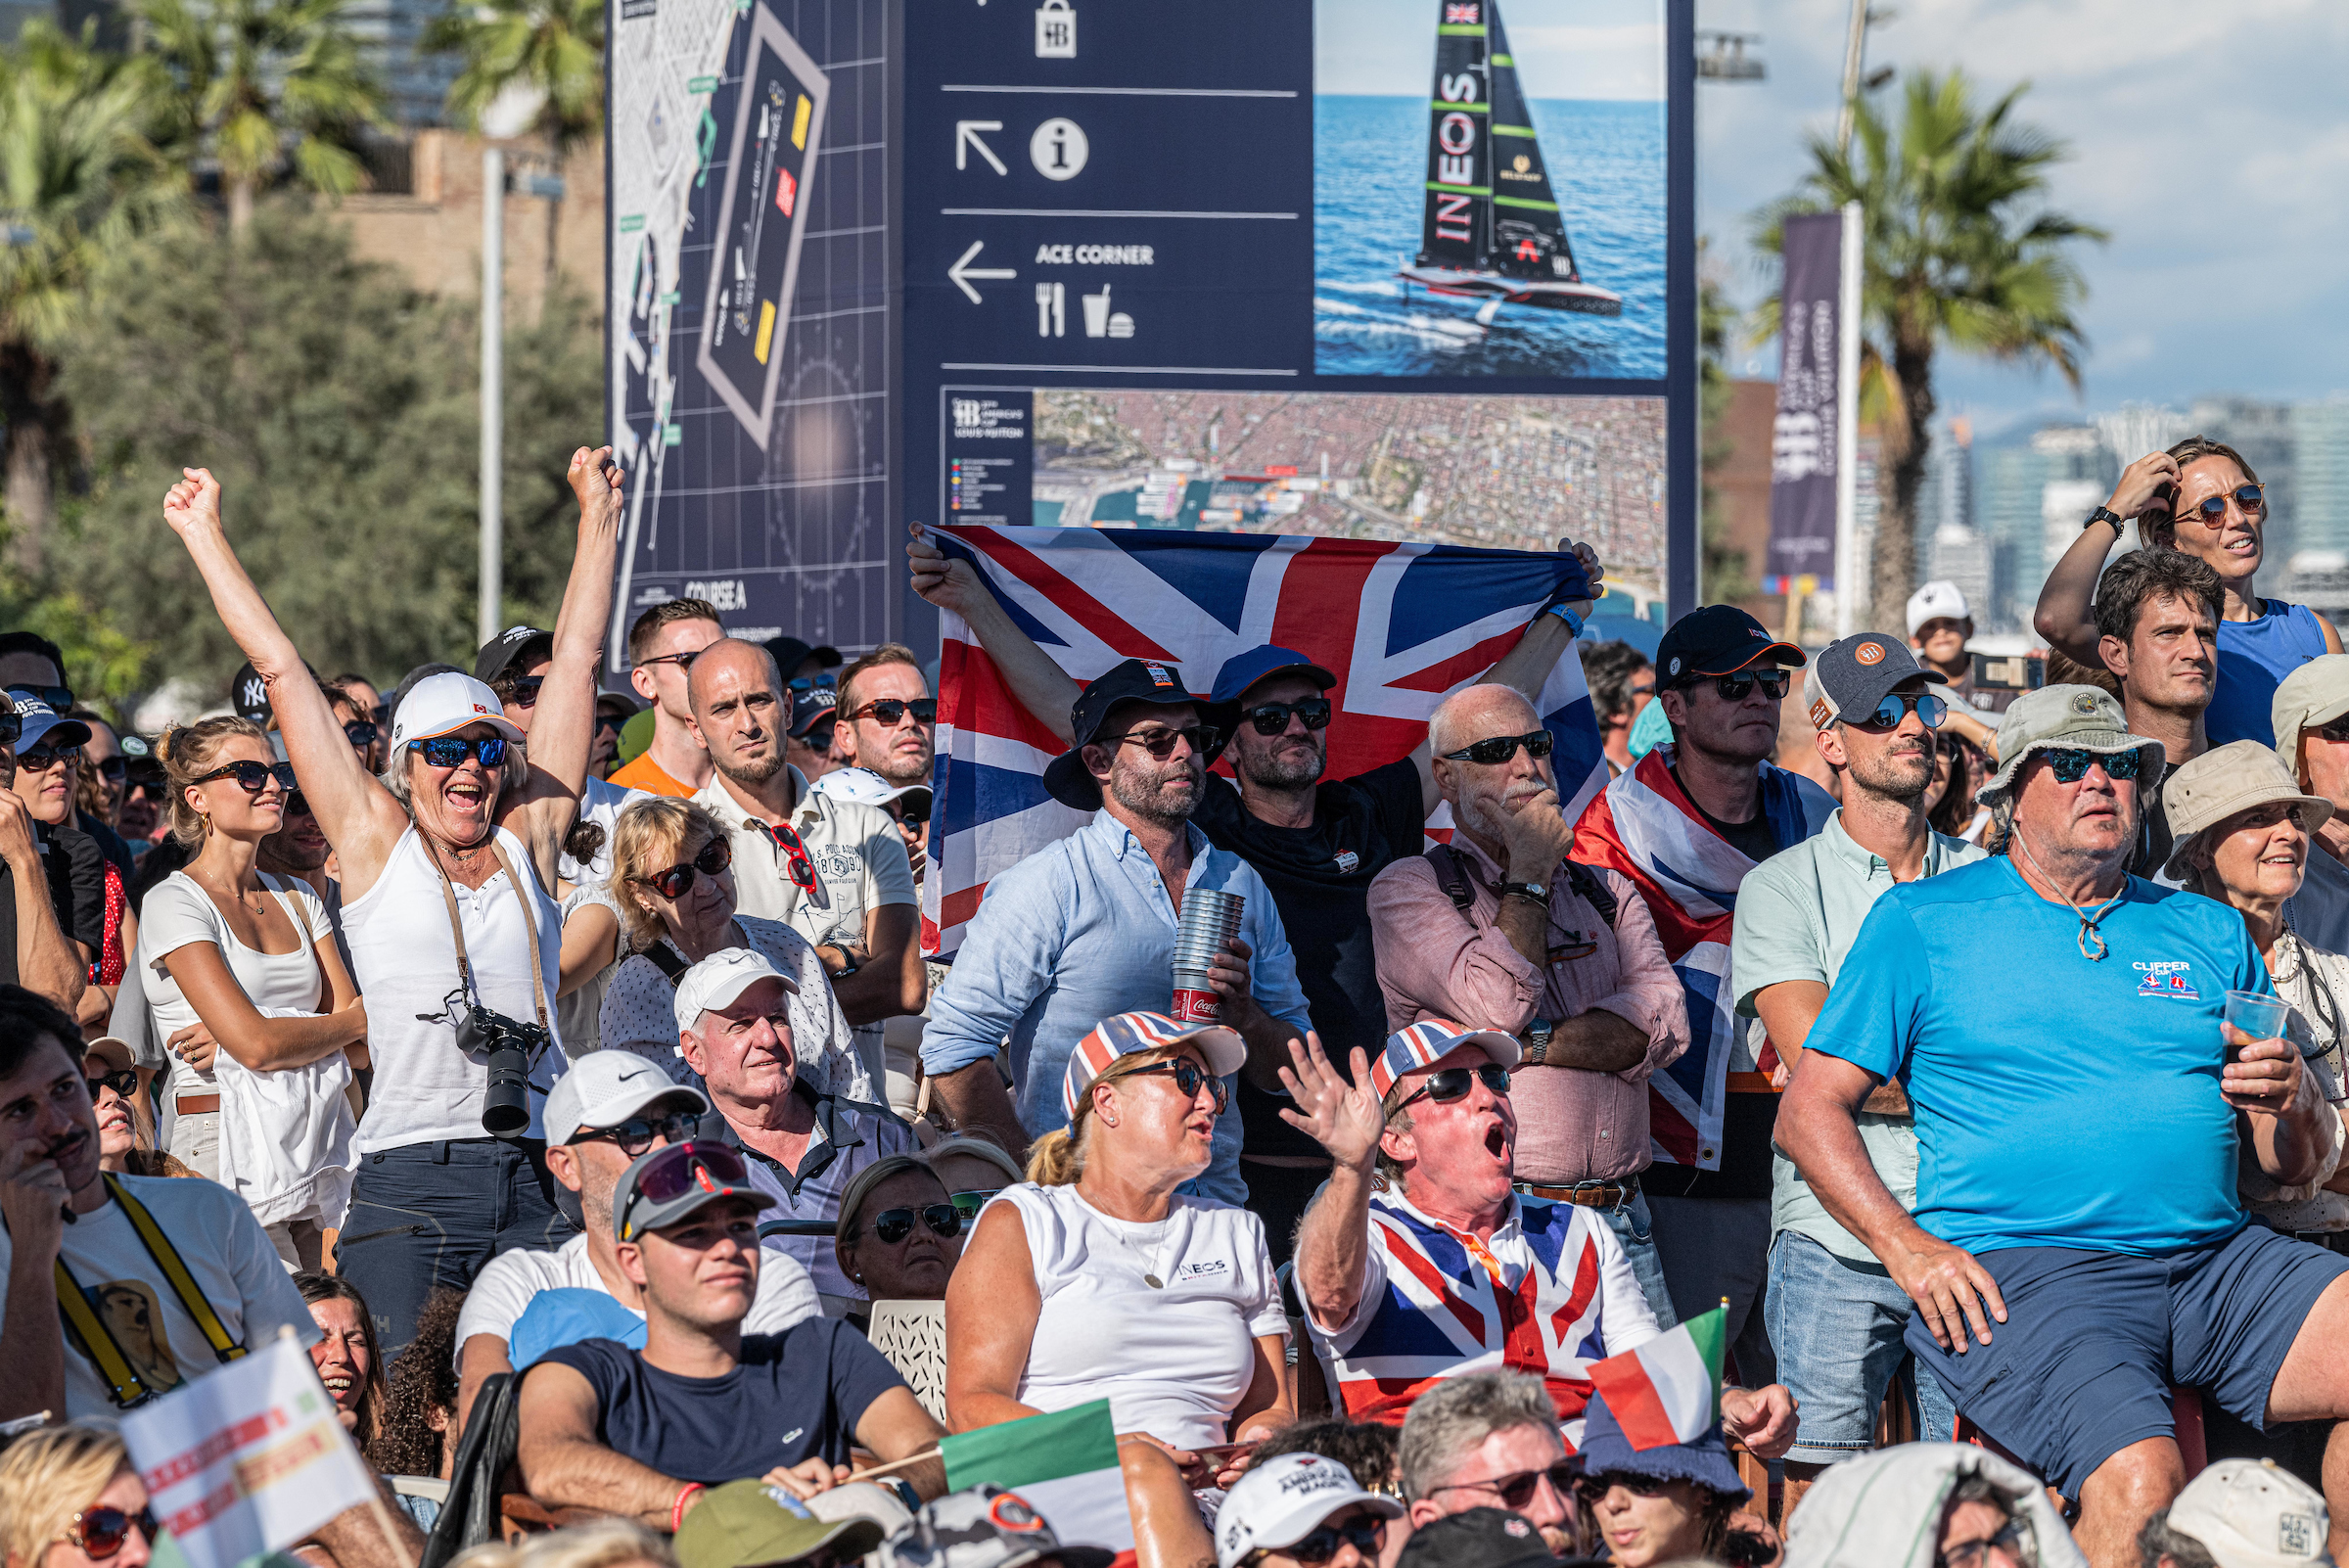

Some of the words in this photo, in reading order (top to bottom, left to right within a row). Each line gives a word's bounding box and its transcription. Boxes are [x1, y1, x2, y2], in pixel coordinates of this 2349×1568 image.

[1436, 72, 1478, 244] INEOS
[1036, 244, 1074, 264] ACE
[1075, 244, 1155, 265] CORNER
[244, 677, 266, 707] NY
[825, 844, 841, 854] POLO
[2132, 961, 2190, 971] CLIPPER
[1177, 1260, 1225, 1275] INEOS
